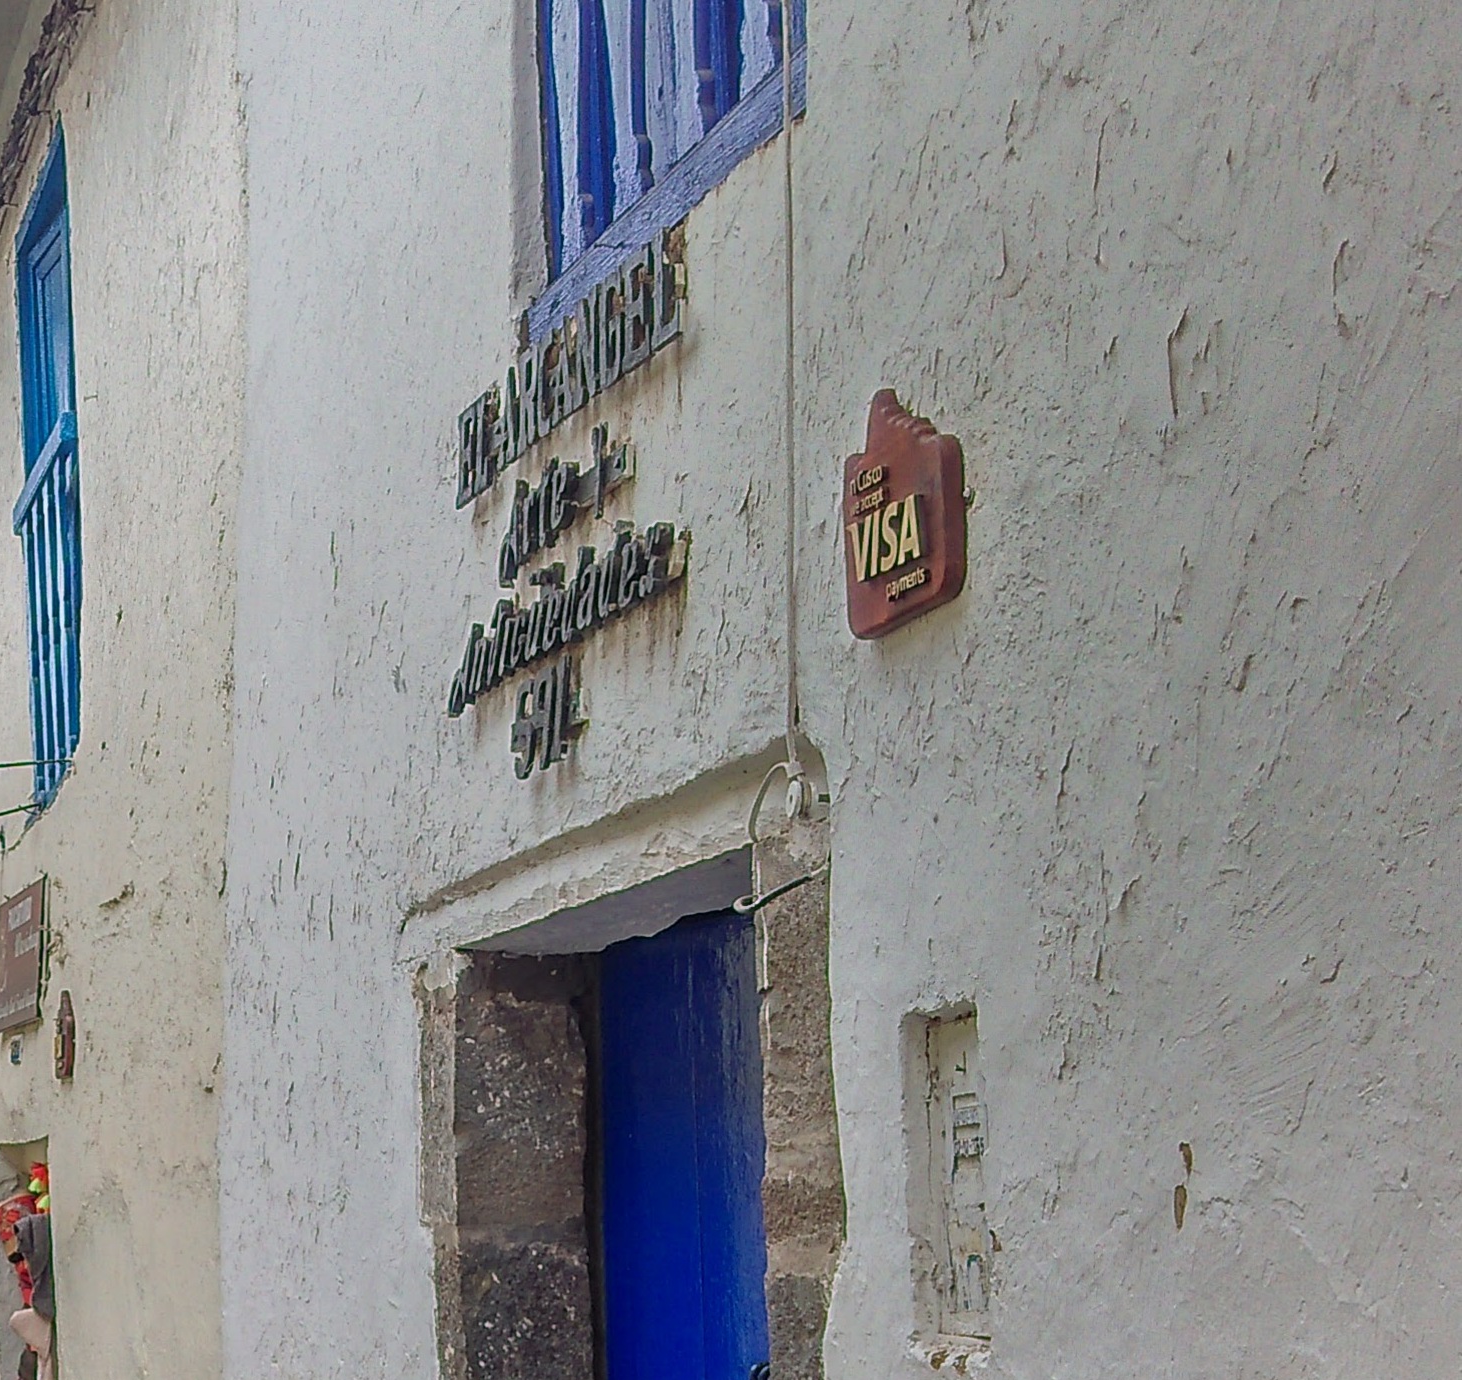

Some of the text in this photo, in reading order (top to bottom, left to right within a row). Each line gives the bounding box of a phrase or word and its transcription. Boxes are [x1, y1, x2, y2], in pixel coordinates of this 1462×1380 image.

[493, 230, 684, 472] ARCANGEL
[846, 493, 921, 582] VISA
[885, 566, 926, 600] payments
